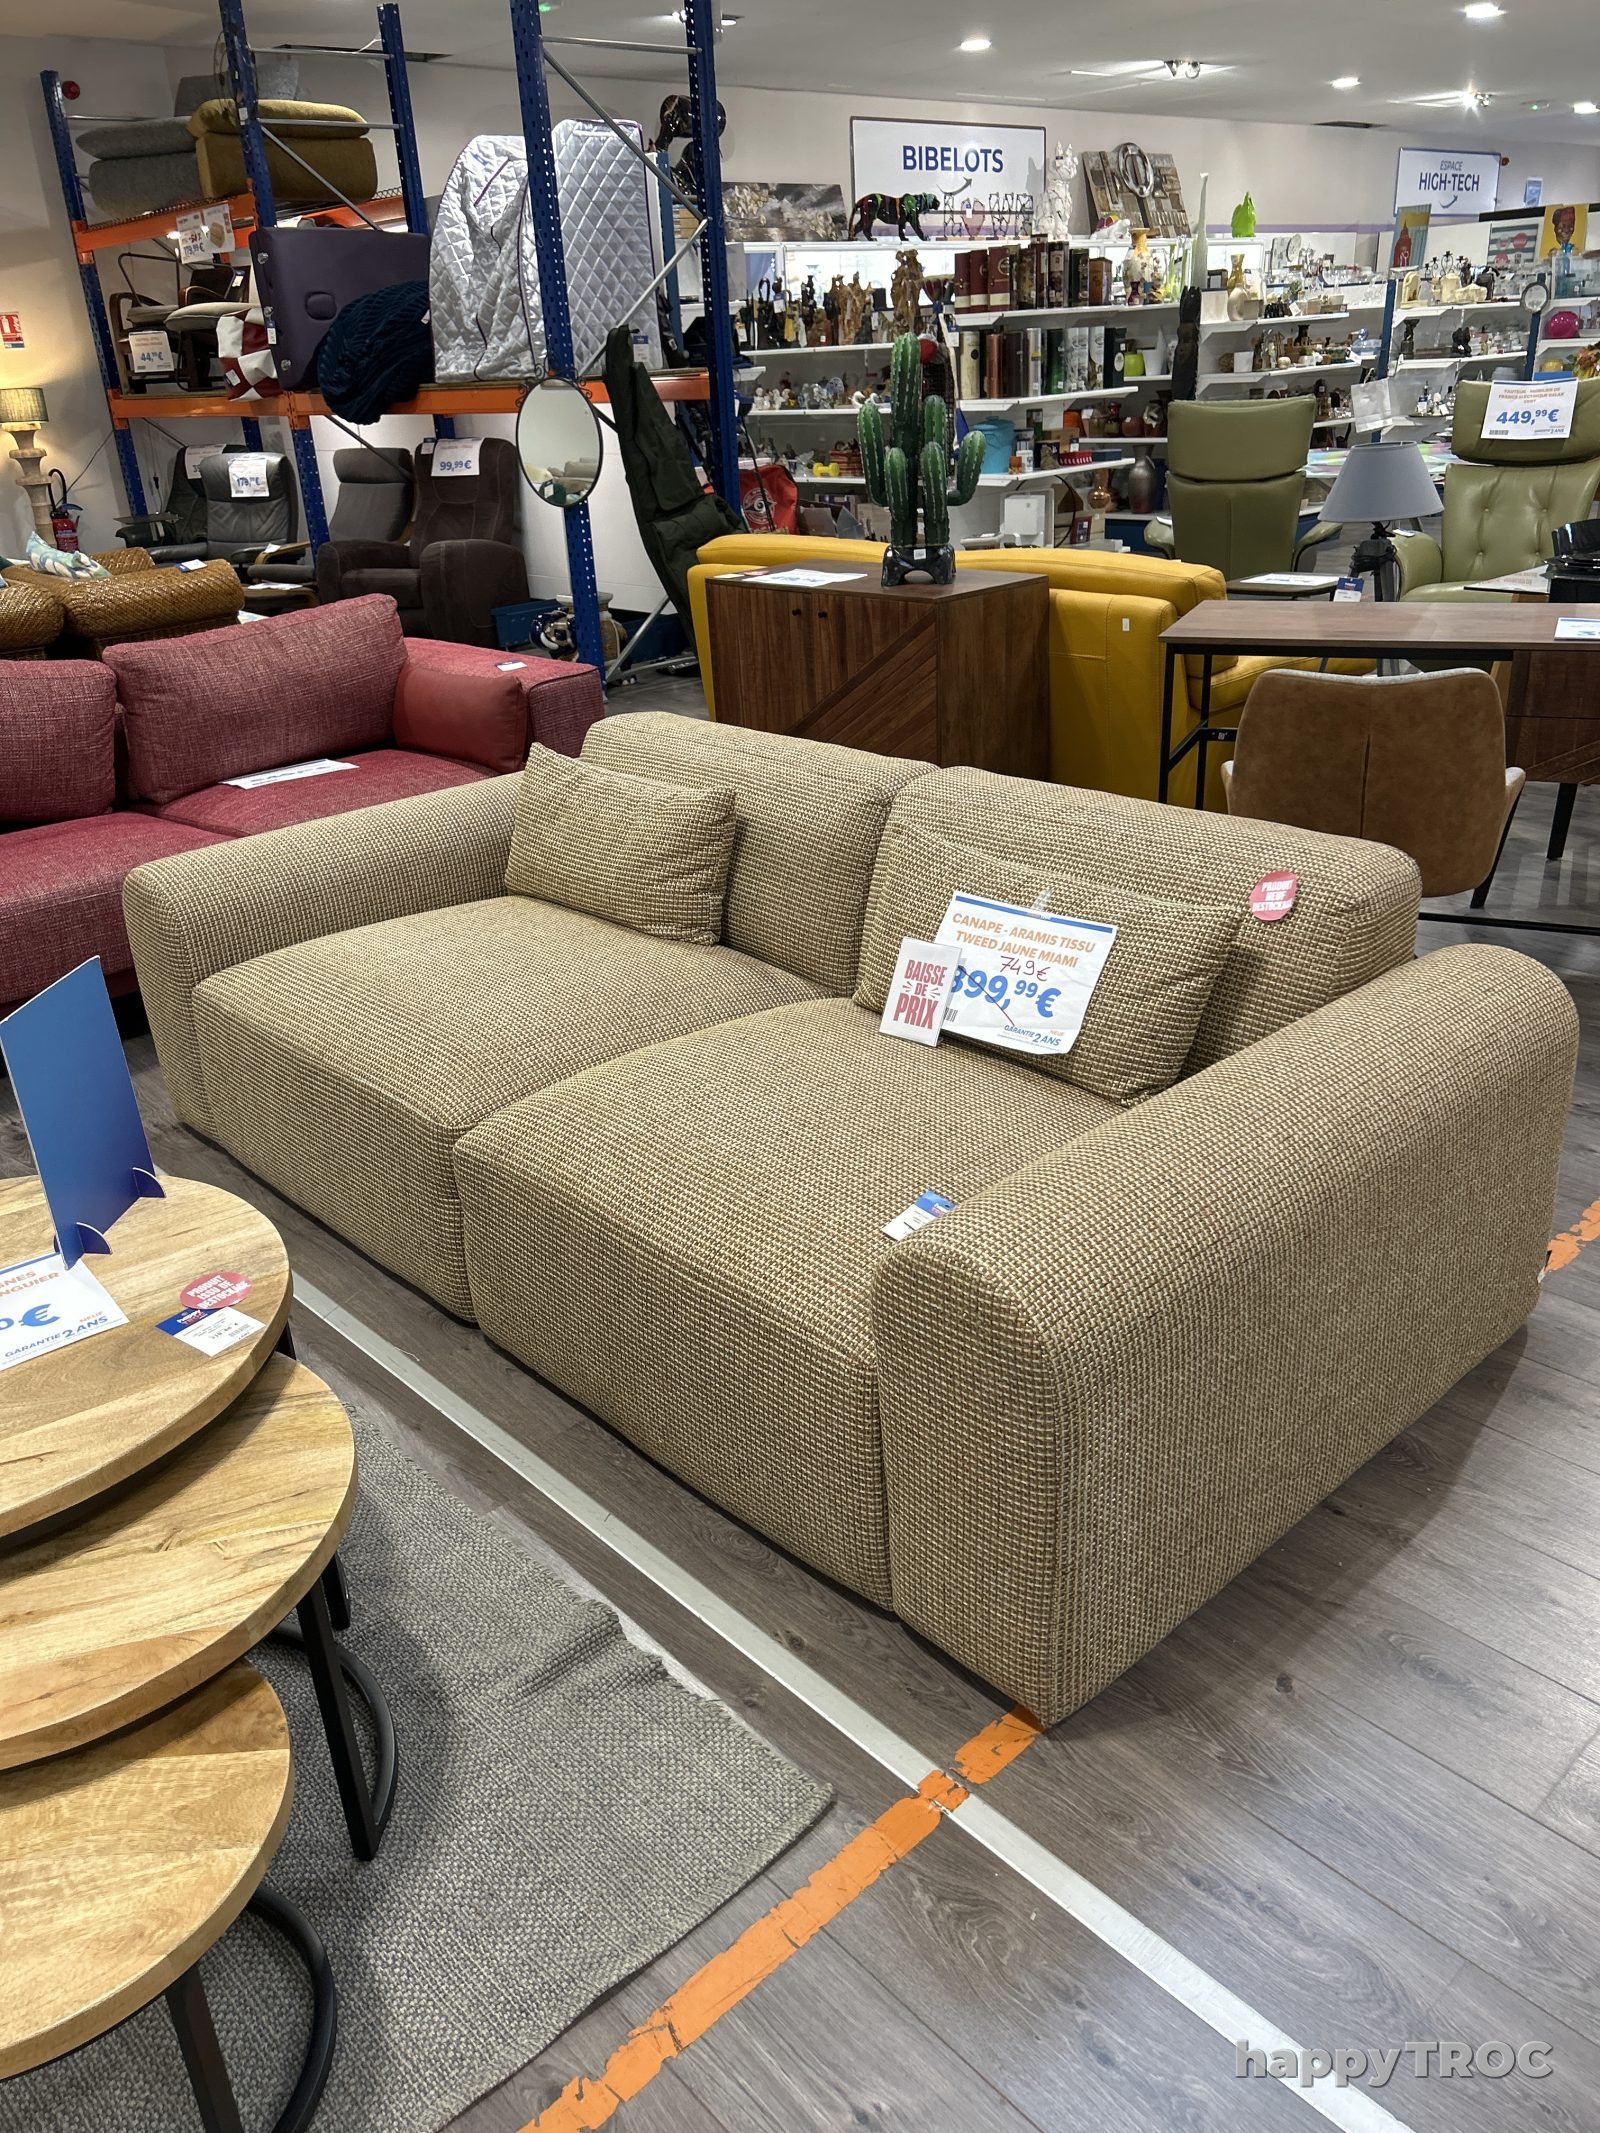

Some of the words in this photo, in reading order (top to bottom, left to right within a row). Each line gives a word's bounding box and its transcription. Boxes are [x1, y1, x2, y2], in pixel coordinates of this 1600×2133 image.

[903, 145, 1004, 173] BIBELOTS
[1439, 160, 1463, 171] ESPACE
[1418, 172, 1480, 192] HIGH-TECH
[1496, 408, 1559, 426] 449,99€
[439, 459, 472, 472] 99,99€
[952, 912, 1004, 934] CANAPE
[1009, 926, 1059, 946] ARAMIS
[1059, 936, 1096, 953] TISSU
[956, 930, 998, 949] TWEED
[998, 941, 1039, 959] JAUNE
[1037, 950, 1079, 968] MIAMI
[904, 959, 948, 987] BAISSE
[1000, 955, 1051, 981] 749€
[914, 982, 929, 997] DE
[893, 992, 939, 1030] PRIX
[1004, 1024, 1035, 1038] GARANTIE
[1033, 1033, 1042, 1043] 2
[1041, 1035, 1062, 1046] ANS
[4, 1333, 61, 1358] GARANTIE
[62, 1329, 76, 1339] 2
[76, 1315, 109, 1335] ANS
